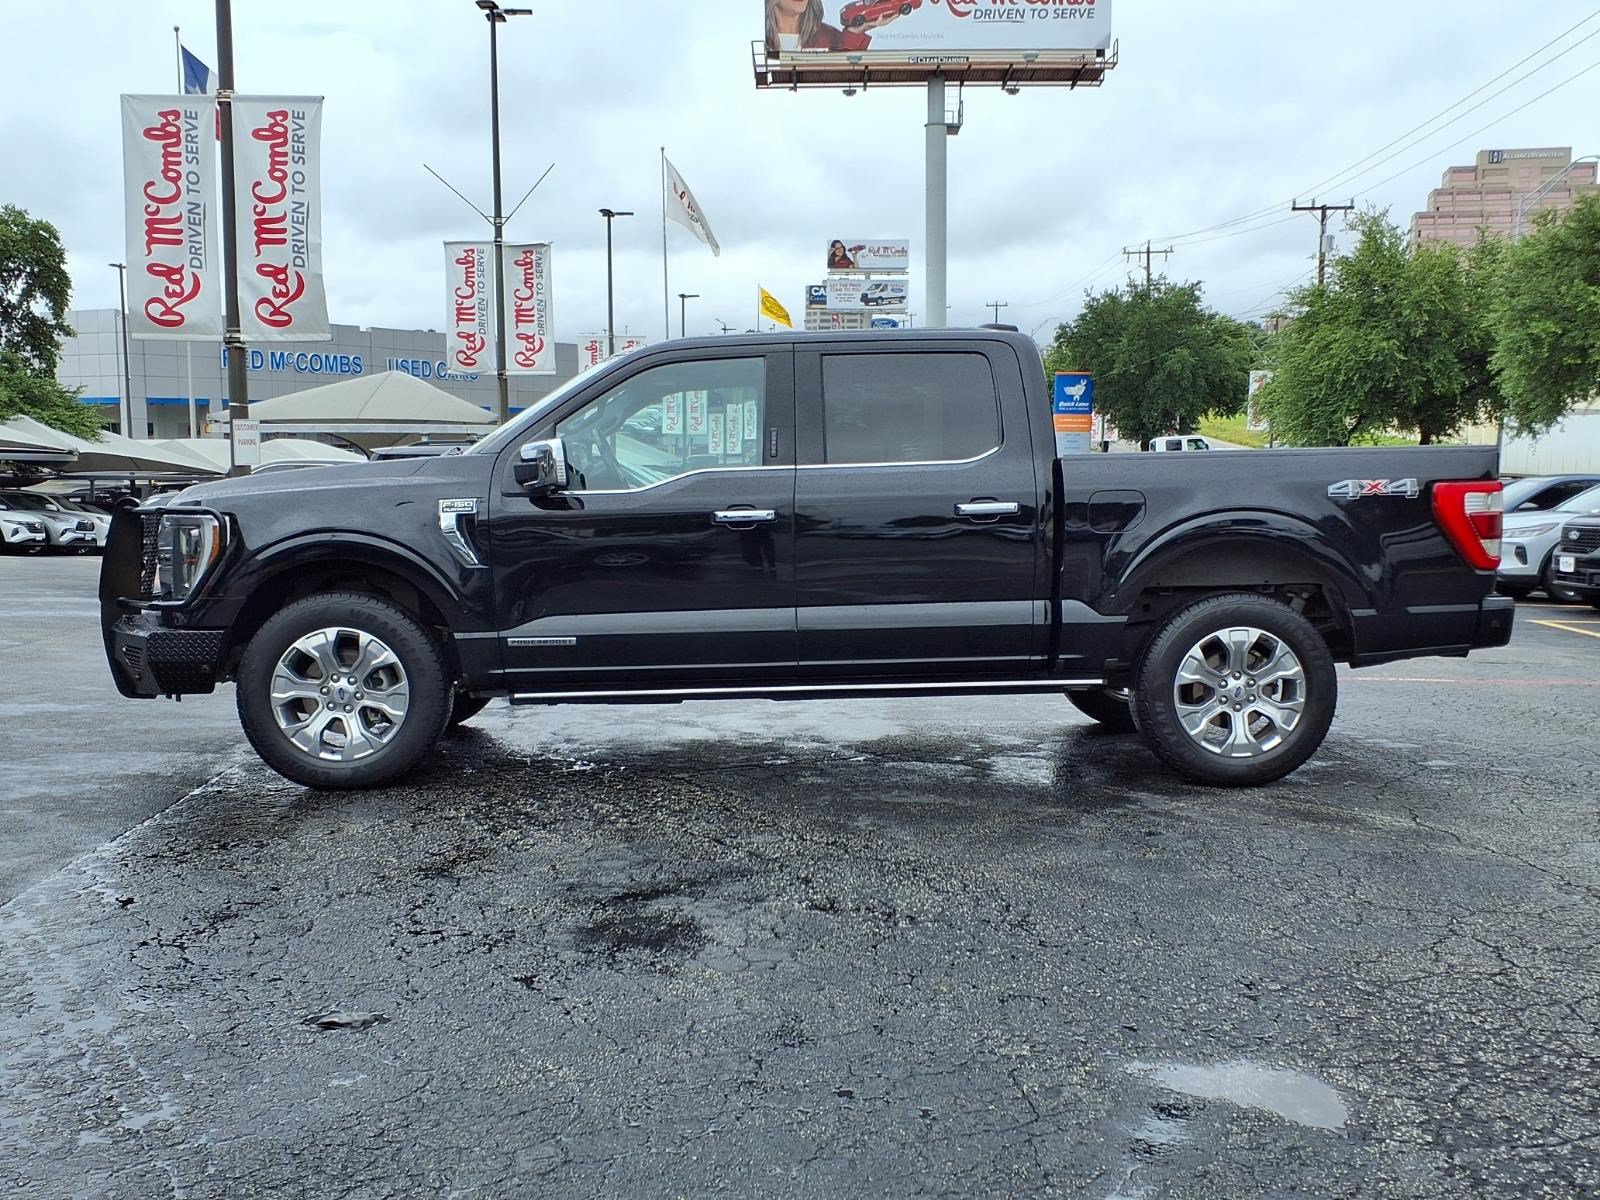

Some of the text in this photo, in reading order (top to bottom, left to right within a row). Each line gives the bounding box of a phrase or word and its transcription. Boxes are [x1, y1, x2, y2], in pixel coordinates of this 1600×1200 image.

[973, 8, 1026, 20] DRIVEN
[1030, 8, 1048, 20] TO
[1052, 7, 1095, 19] SERVE
[142, 108, 201, 328] Red McCombs
[184, 109, 204, 270] DRIVEN TO SERVE
[251, 108, 305, 328] Red McCombs
[291, 109, 306, 269] DRIVEN TO SERVE
[454, 248, 476, 328] McCombs
[476, 248, 487, 336] DRIVEN TO SERVE
[513, 249, 544, 368] Red McCombs
[534, 249, 546, 337] DRIVEN TO SERVE
[455, 331, 486, 367] Red
